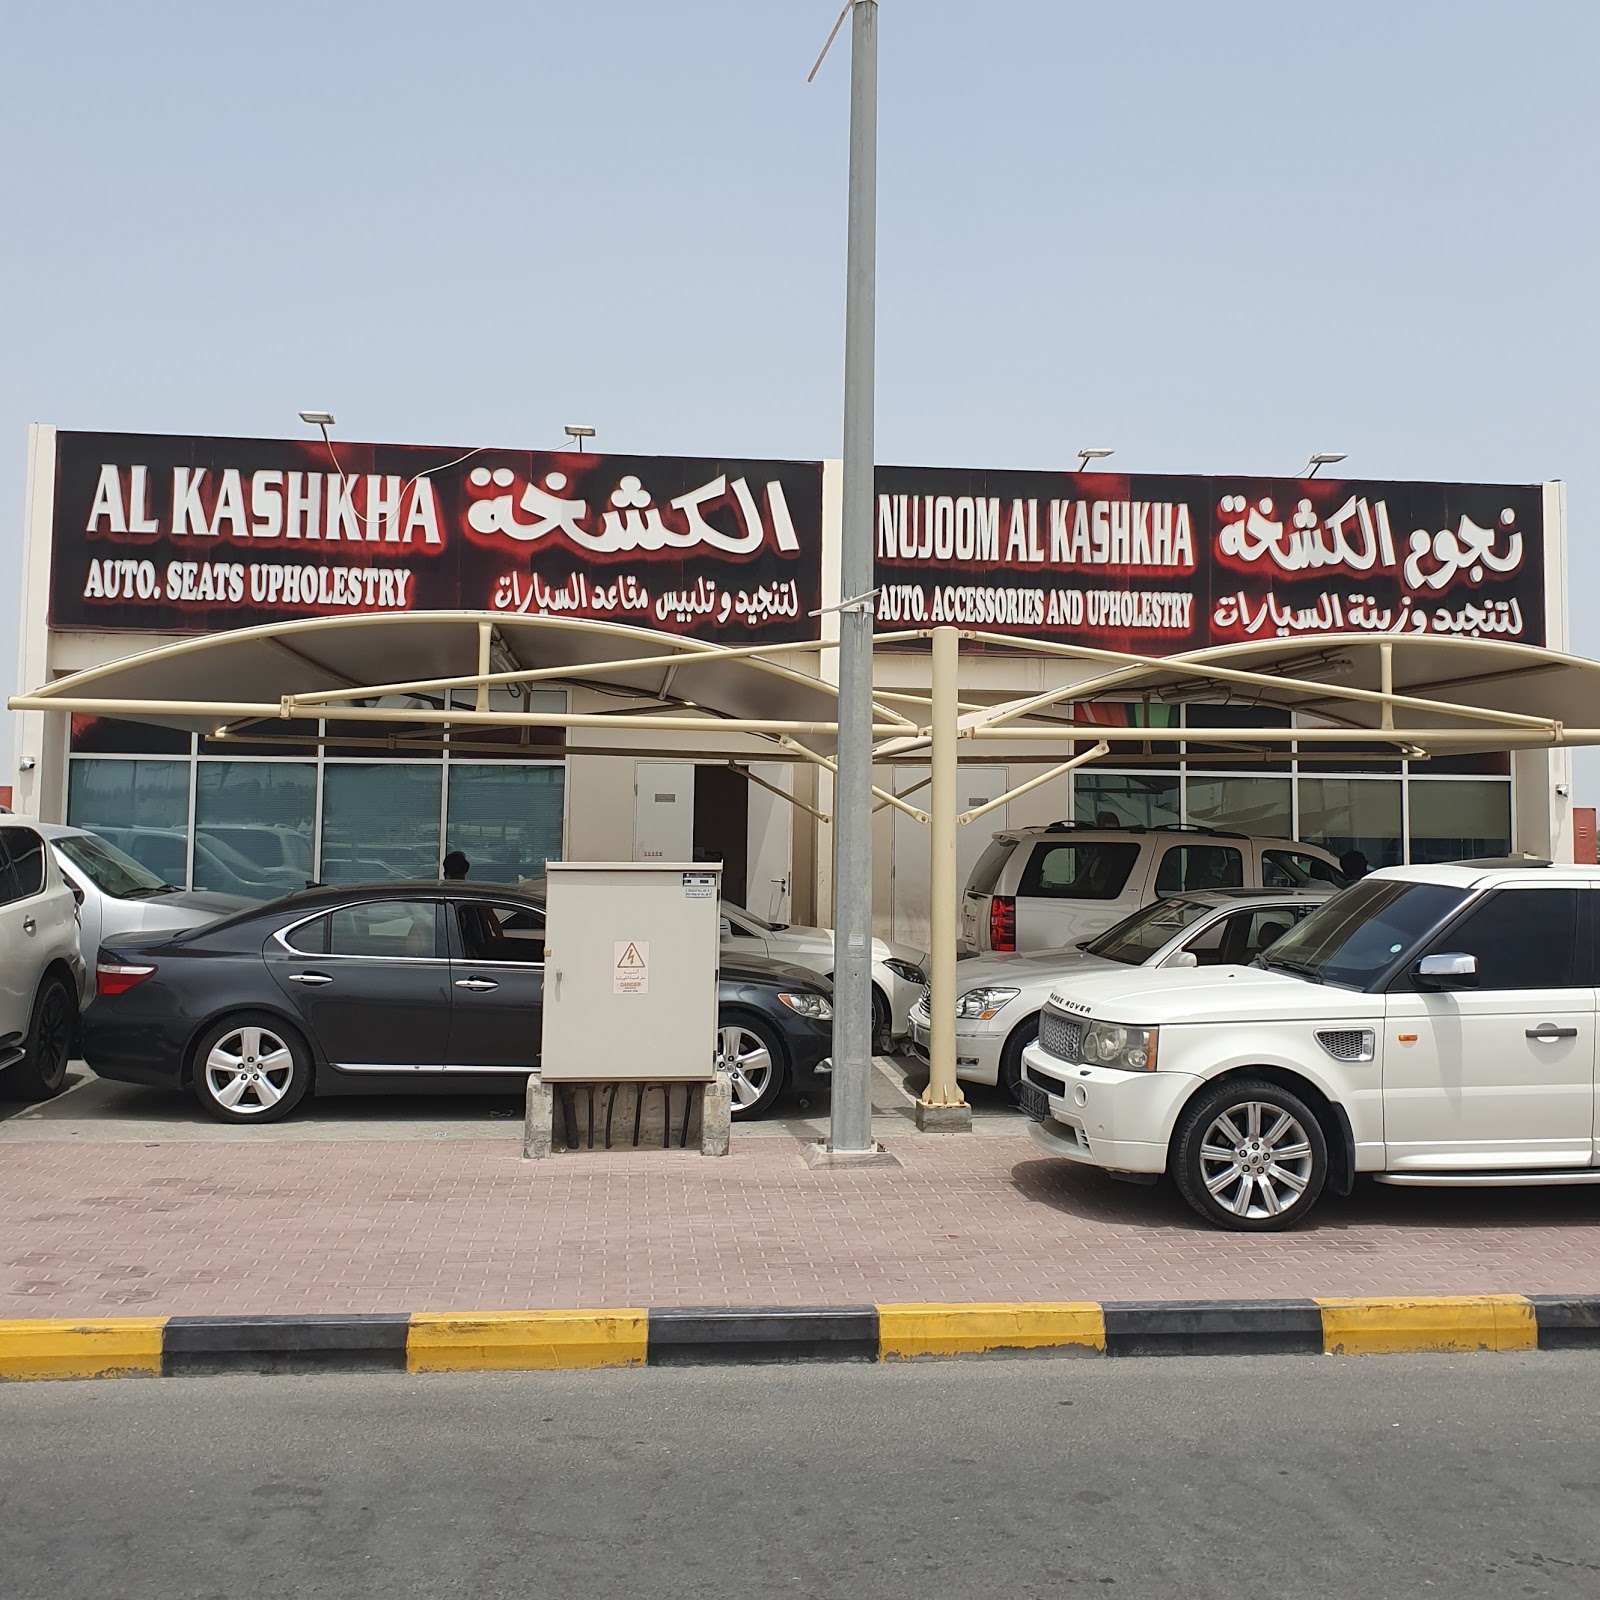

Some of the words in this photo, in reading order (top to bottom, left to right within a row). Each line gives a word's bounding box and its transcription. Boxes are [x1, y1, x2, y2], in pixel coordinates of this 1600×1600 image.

[86, 463, 159, 534] AL
[171, 466, 442, 544] KASHKHA
[467, 467, 800, 554] الكشخة
[877, 493, 1000, 562] NUJOOM
[1005, 498, 1045, 563] AL
[1049, 498, 1195, 567] KASHKHA
[1218, 494, 1397, 571] الكشخة
[1403, 507, 1524, 590] نجوم
[84, 558, 162, 600] AUTO.
[166, 561, 245, 602] SEATS
[249, 563, 412, 607] UPHOLESTRY
[494, 570, 588, 614] السيارات
[591, 574, 649, 610] مقاعد
[735, 578, 799, 625] لتنجيد
[876, 583, 929, 623] AUTO.
[930, 585, 1045, 626] ACCESSORIES
[1045, 588, 1083, 626] AND
[1086, 589, 1194, 629] UPHOLESTRY
[1213, 591, 1345, 637] السيارات
[1431, 597, 1524, 637] لتنجيد
[1065, 1000, 1092, 1013] ROVER
